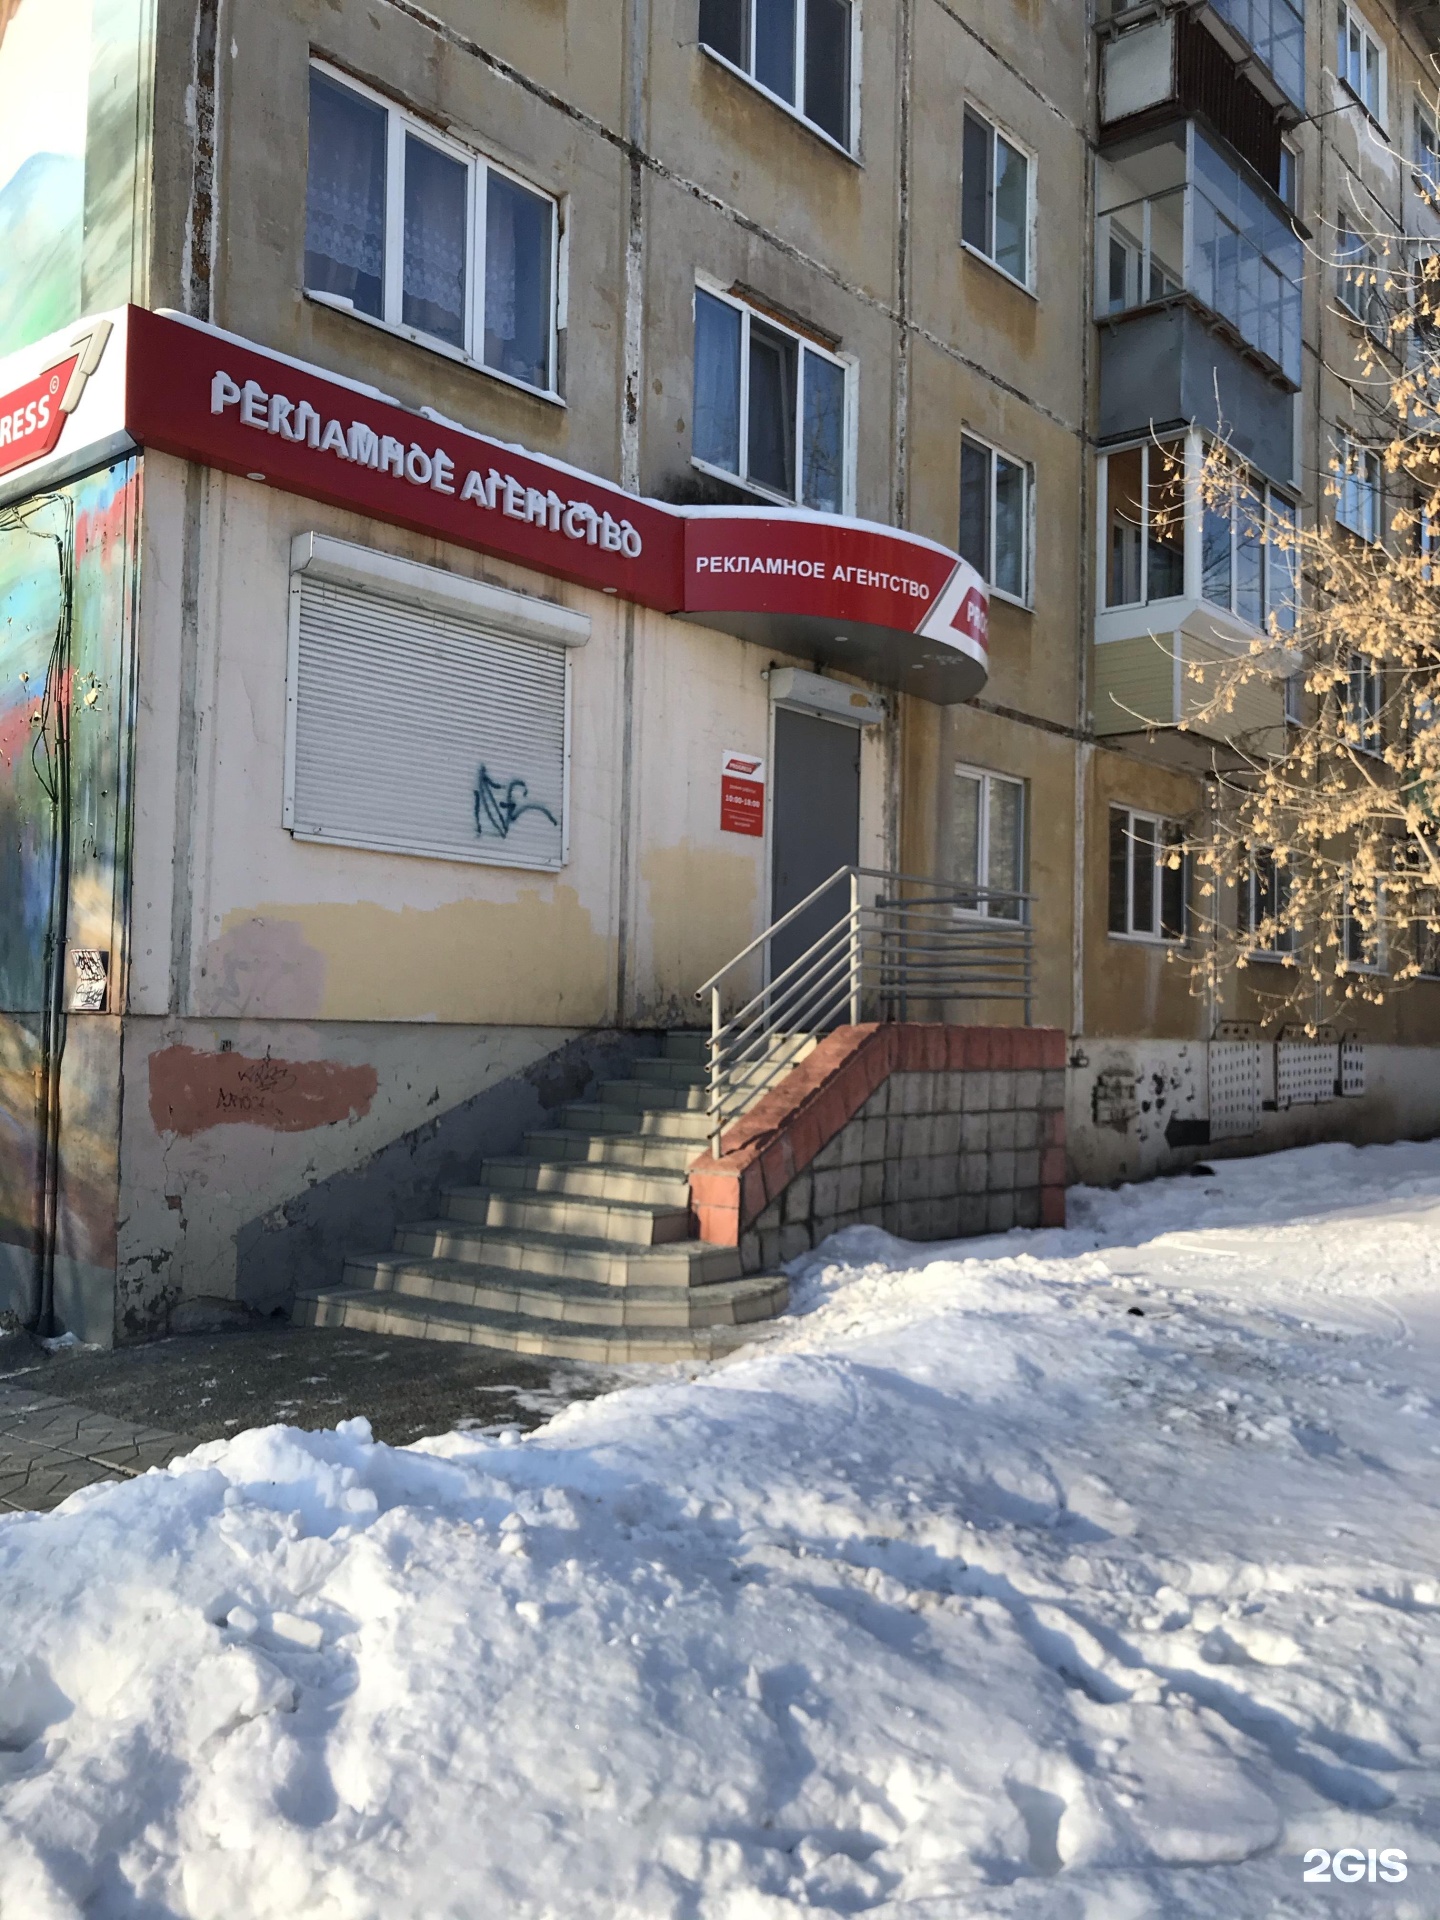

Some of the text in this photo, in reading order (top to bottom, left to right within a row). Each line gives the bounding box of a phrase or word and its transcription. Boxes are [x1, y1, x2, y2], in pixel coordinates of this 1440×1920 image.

[210, 370, 642, 559] РЕКЛАМНОЕ АГЕНТСТВО
[696, 556, 930, 600] РЕКЛАМНОЕ АГЕНТСТВО
